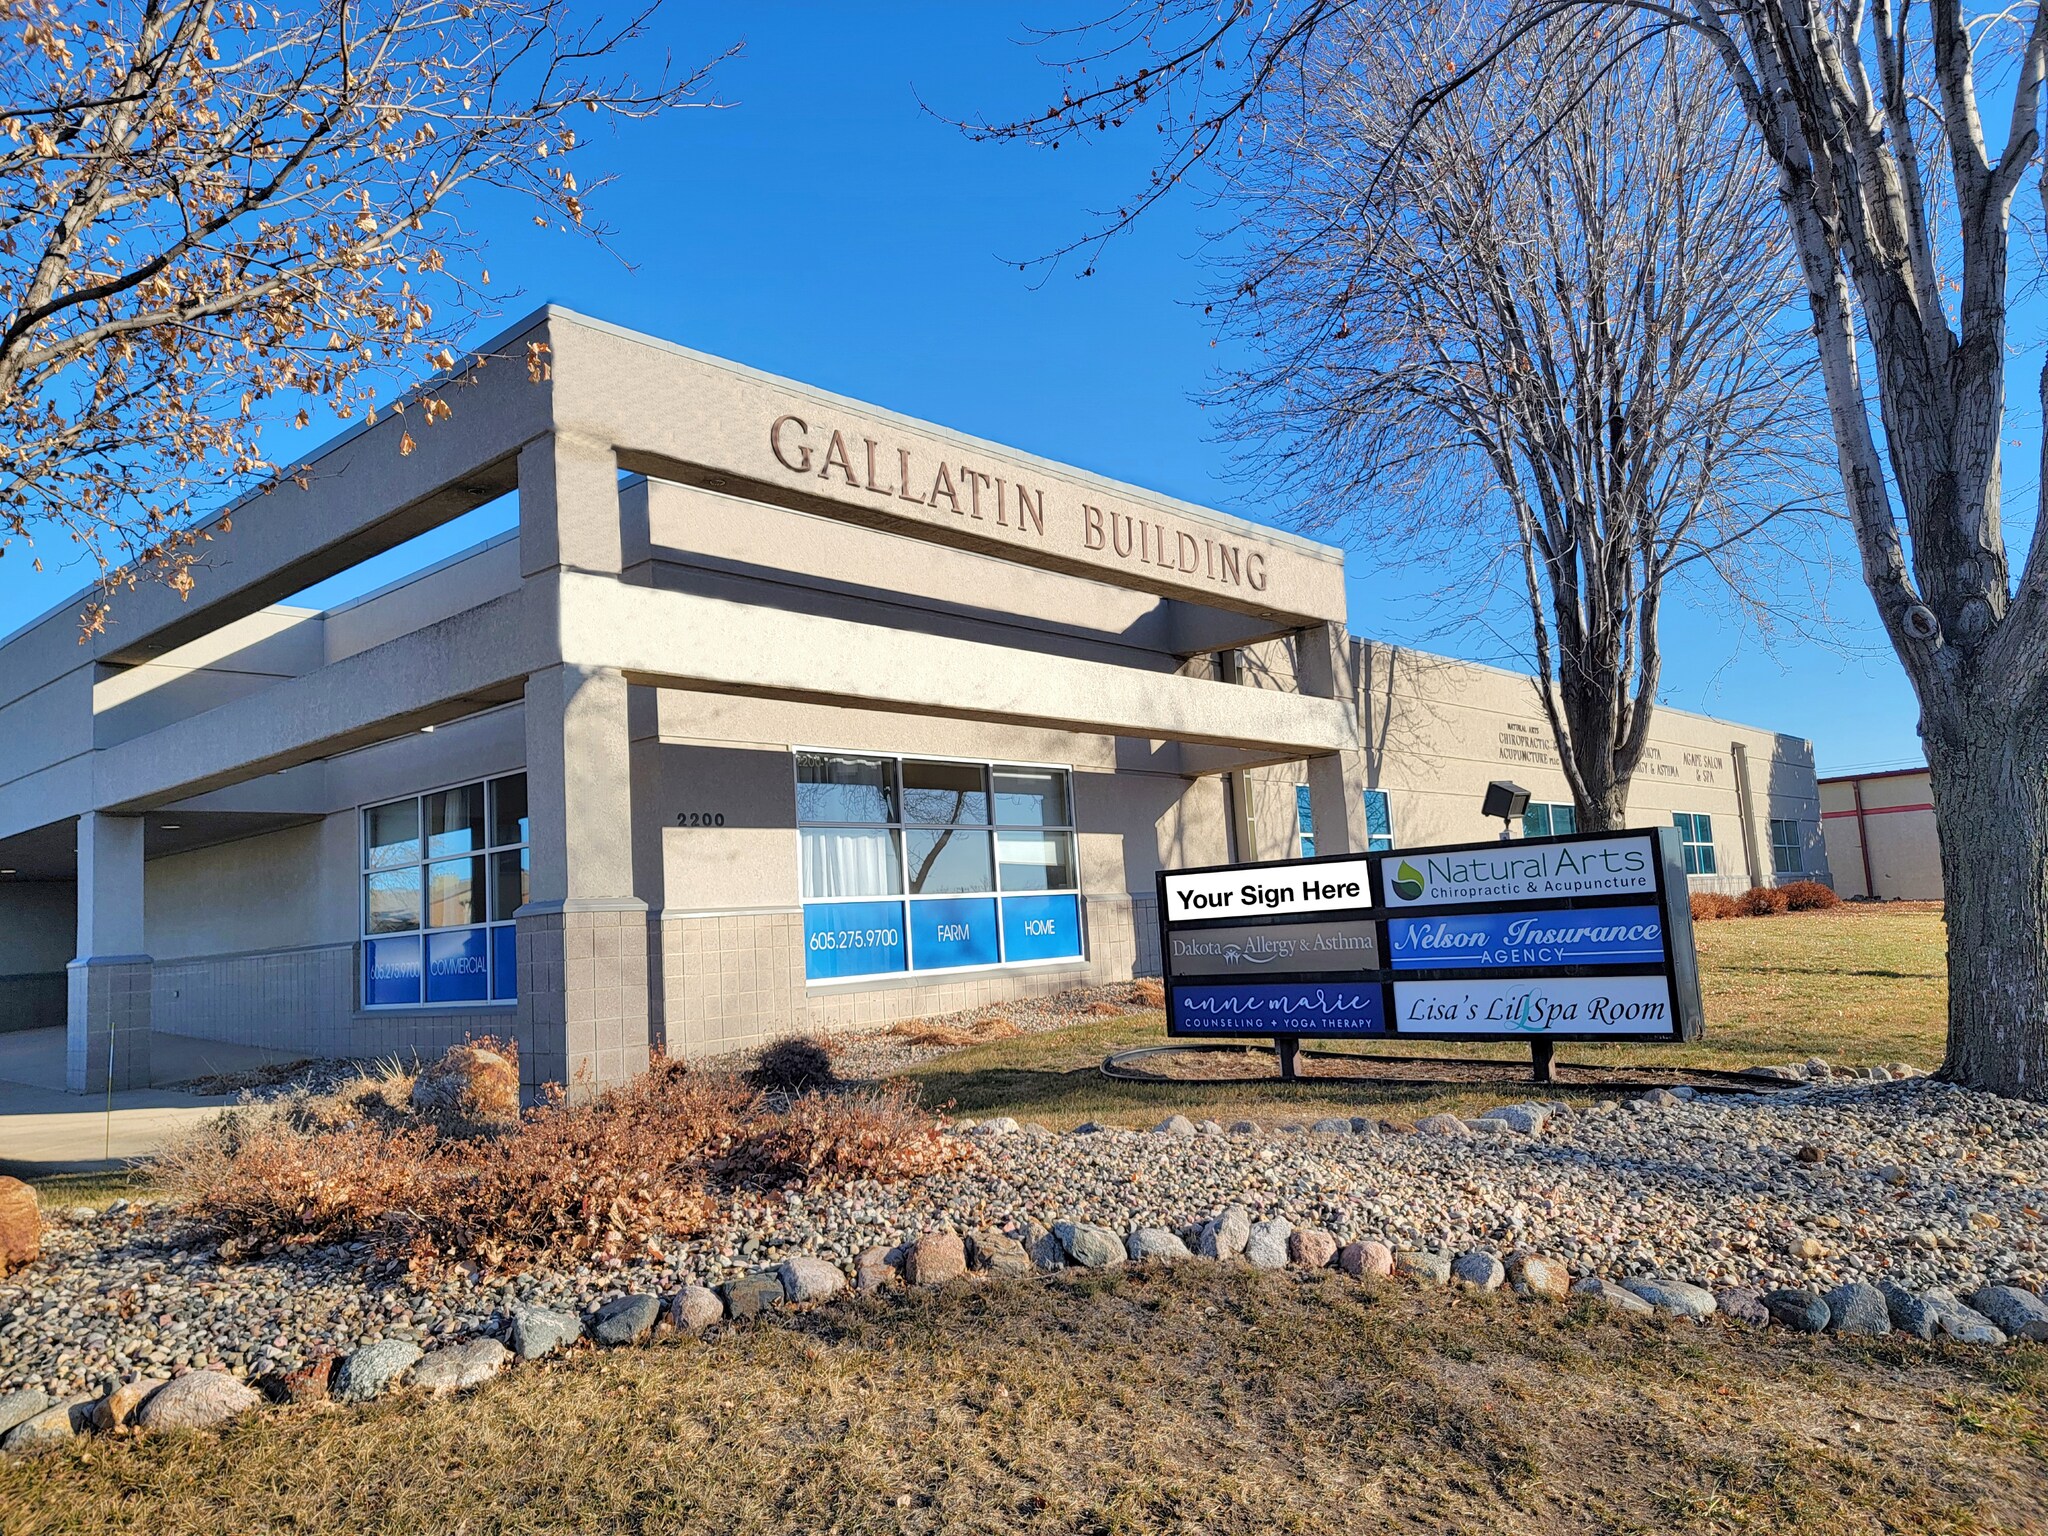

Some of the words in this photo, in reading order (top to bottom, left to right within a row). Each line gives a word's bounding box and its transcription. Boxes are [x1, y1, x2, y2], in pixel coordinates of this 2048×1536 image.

[770, 414, 1045, 537] GALLATIN
[1082, 503, 1268, 591] BUILDING
[1507, 723, 1527, 732] NATURAL
[1499, 733, 1549, 750] CHIROPRACTIC
[1499, 748, 1548, 764] ACUPUNCTURE
[1683, 752, 1702, 767] AGAPE
[1704, 755, 1722, 769] SALON
[1657, 765, 1680, 777] ASTHMA
[1703, 771, 1714, 783] SPA
[677, 812, 725, 827] 2200
[1428, 852, 1547, 884] Natural
[1555, 847, 1645, 877] Arts
[1177, 889, 1233, 910] Your
[1241, 884, 1294, 908] Sign
[1302, 880, 1360, 901] Here
[1430, 883, 1521, 899] Chiropractic
[1527, 881, 1538, 893] &
[1544, 875, 1647, 893] Acupuncture
[937, 923, 970, 942] FARM
[1024, 919, 1055, 936] HOME
[1394, 923, 1491, 951] Nelson
[1502, 918, 1661, 946] Insurance
[809, 929, 898, 950] 605.275.9700
[1172, 939, 1222, 956] Dakota
[1244, 935, 1297, 957] Allergy
[1299, 939, 1311, 951] &
[1313, 932, 1373, 951] Asthma
[1481, 947, 1565, 964] AGENCY
[370, 961, 420, 980] 605.275.9700
[430, 956, 487, 976] COMMERCIAL
[1184, 996, 1265, 1014] anne
[1268, 989, 1370, 1014] marie
[1407, 994, 1478, 1021] Lisa's
[1528, 997, 1578, 1030] Spa
[1587, 996, 1665, 1026] Room
[1185, 1018, 1263, 1028] COUNSELING
[1284, 1018, 1317, 1029] YOGA
[1321, 1018, 1373, 1029] THERAPY
